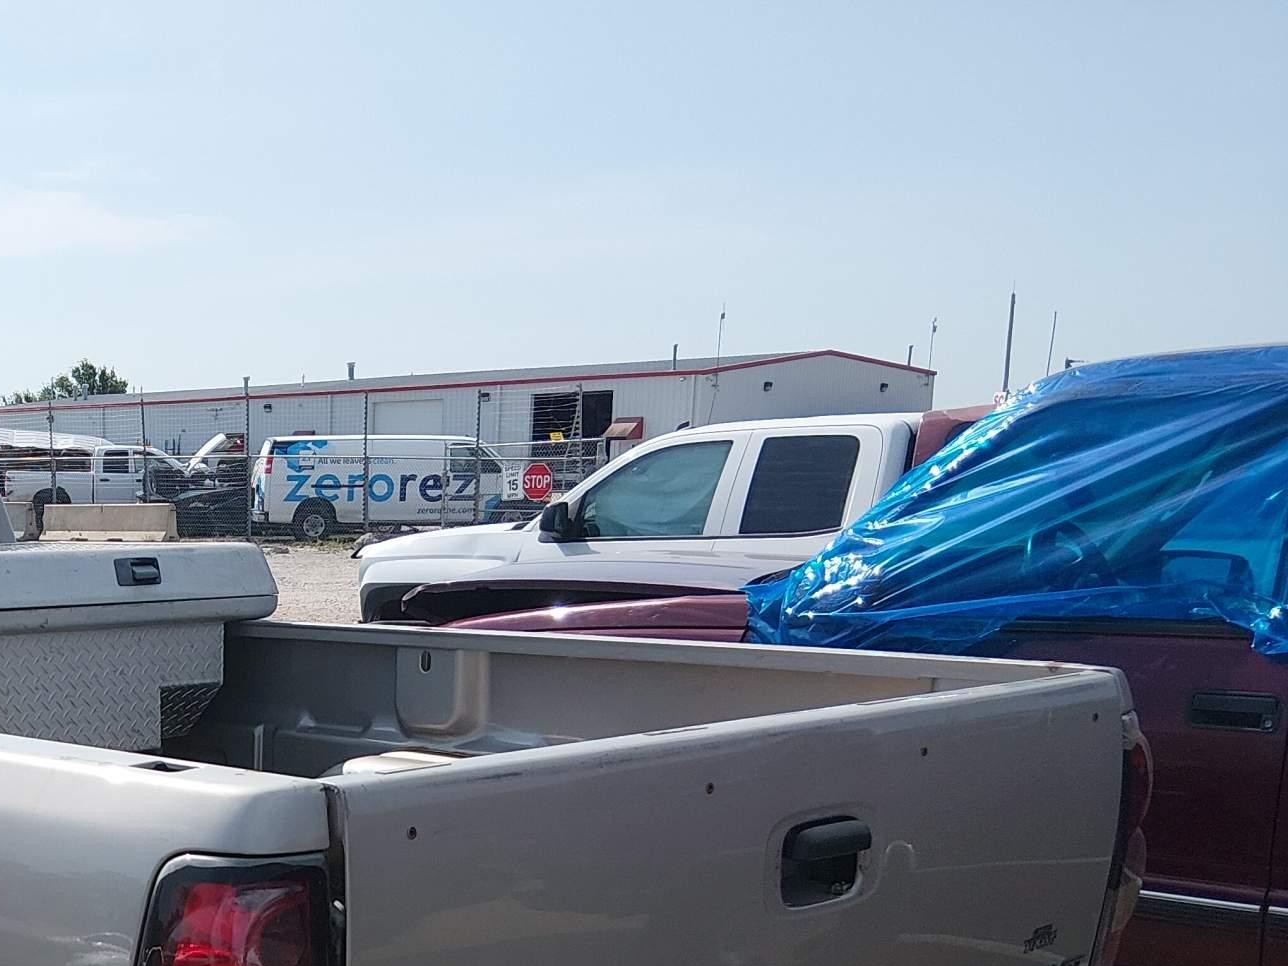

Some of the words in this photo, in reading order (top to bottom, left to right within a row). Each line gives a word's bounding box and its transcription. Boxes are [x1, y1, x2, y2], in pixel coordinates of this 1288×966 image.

[318, 457, 328, 465] All
[330, 457, 341, 465] we
[283, 473, 478, 502] zerorez
[506, 478, 519, 491] 15
[523, 475, 551, 489] STOP
